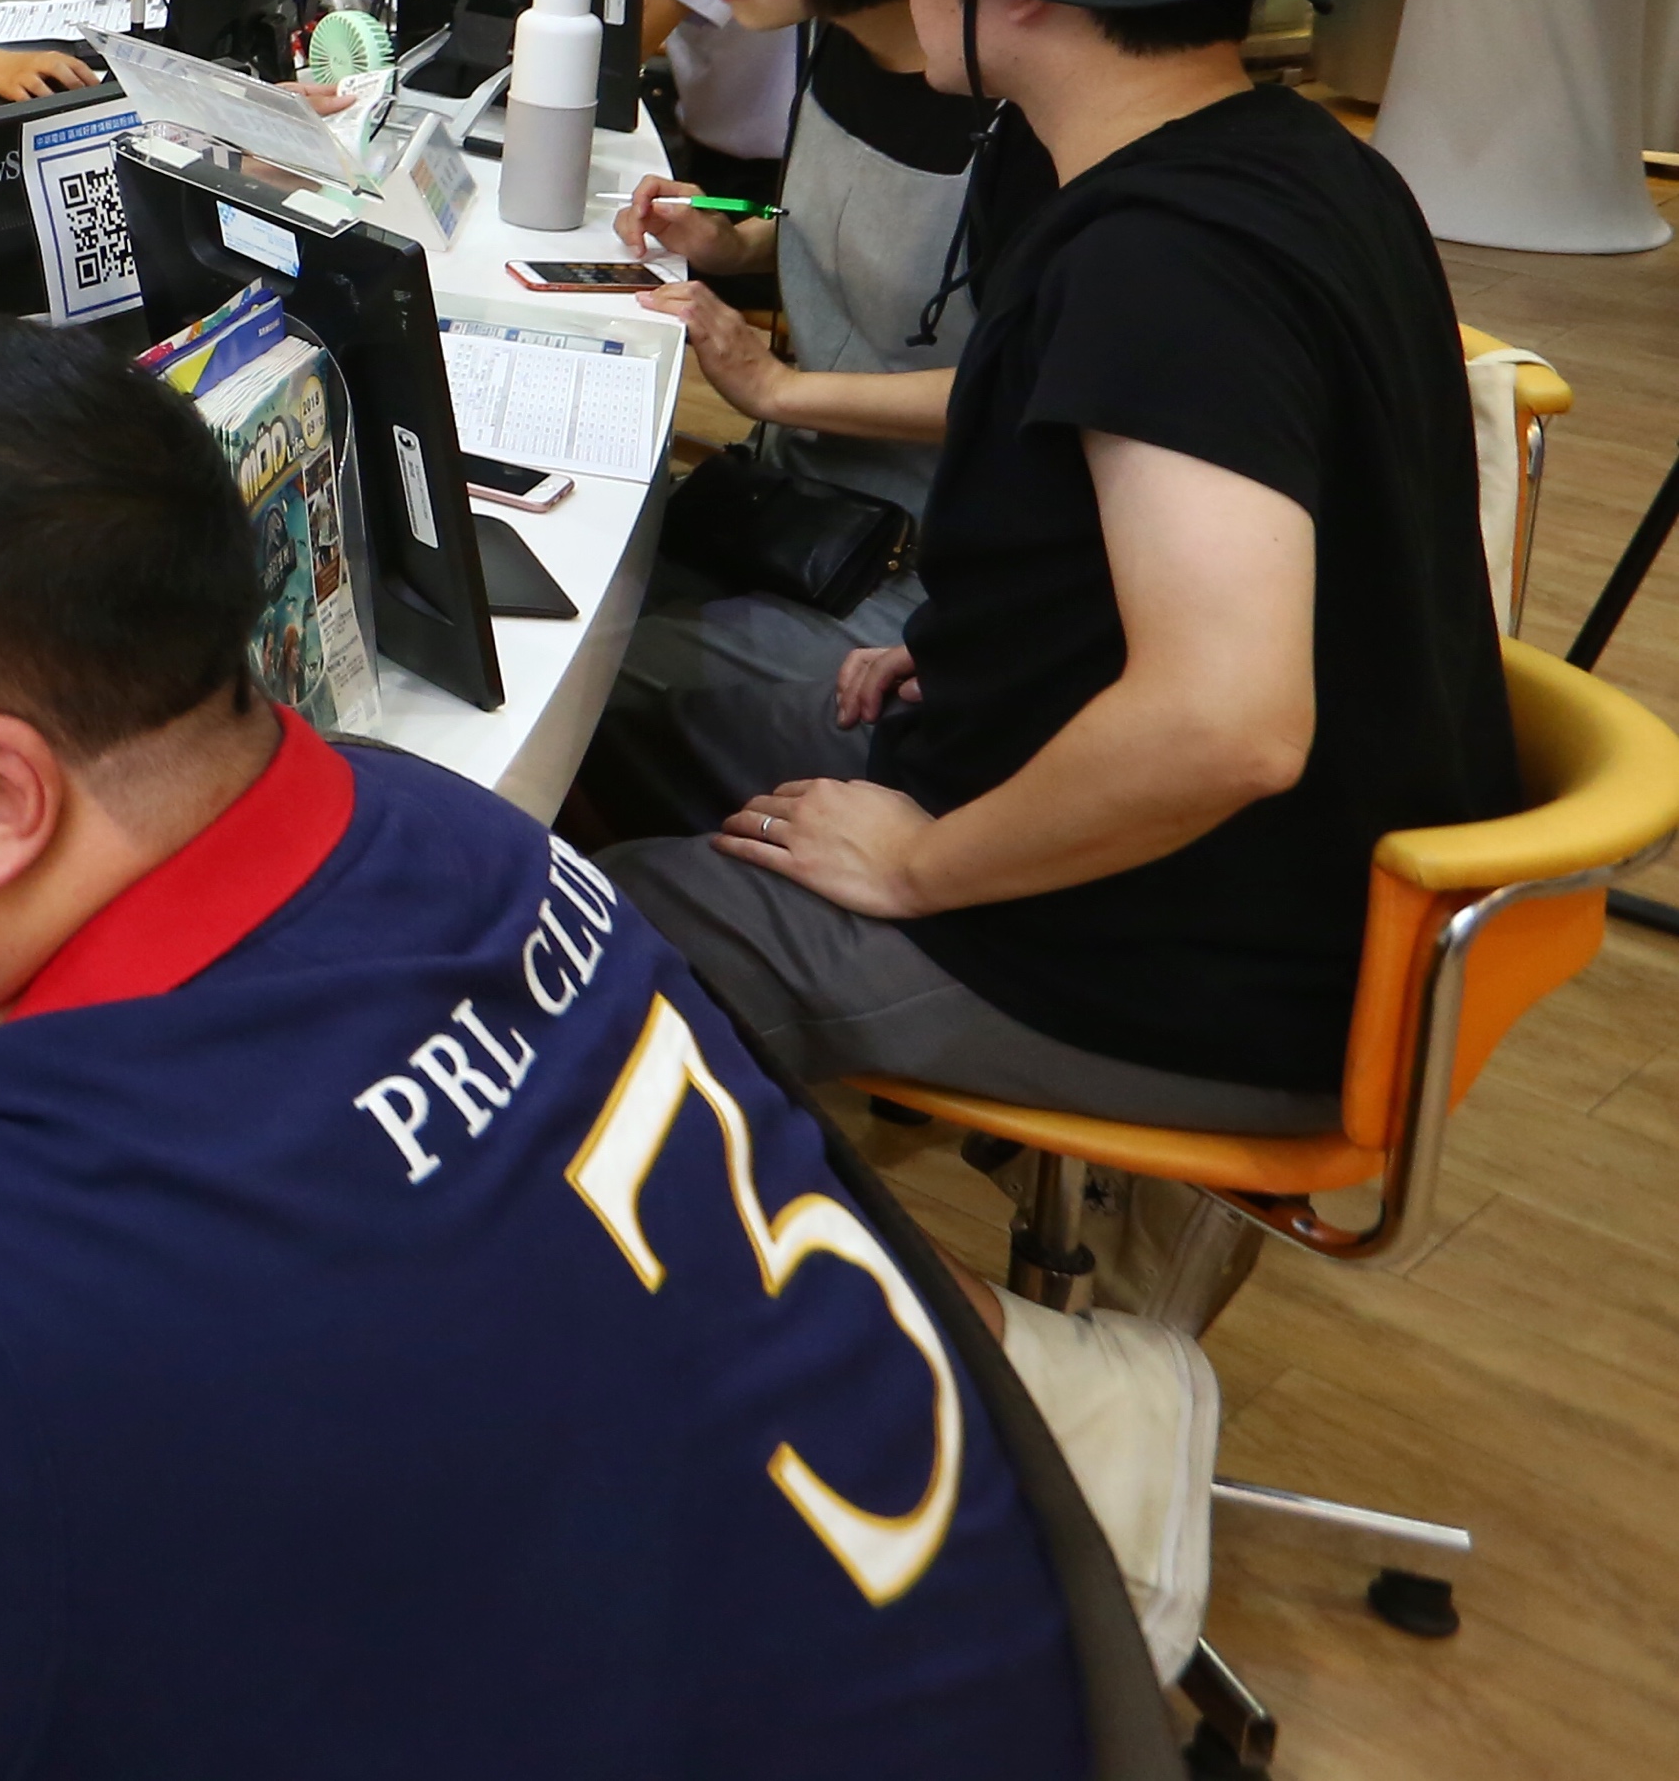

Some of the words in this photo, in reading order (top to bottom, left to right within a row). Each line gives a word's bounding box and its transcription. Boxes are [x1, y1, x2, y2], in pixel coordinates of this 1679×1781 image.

[258, 318, 280, 337] SAMSUNG
[302, 391, 320, 417] 2018
[354, 998, 534, 1186] PRL
[522, 832, 620, 1020] CLUB
[564, 992, 964, 1608] 3
